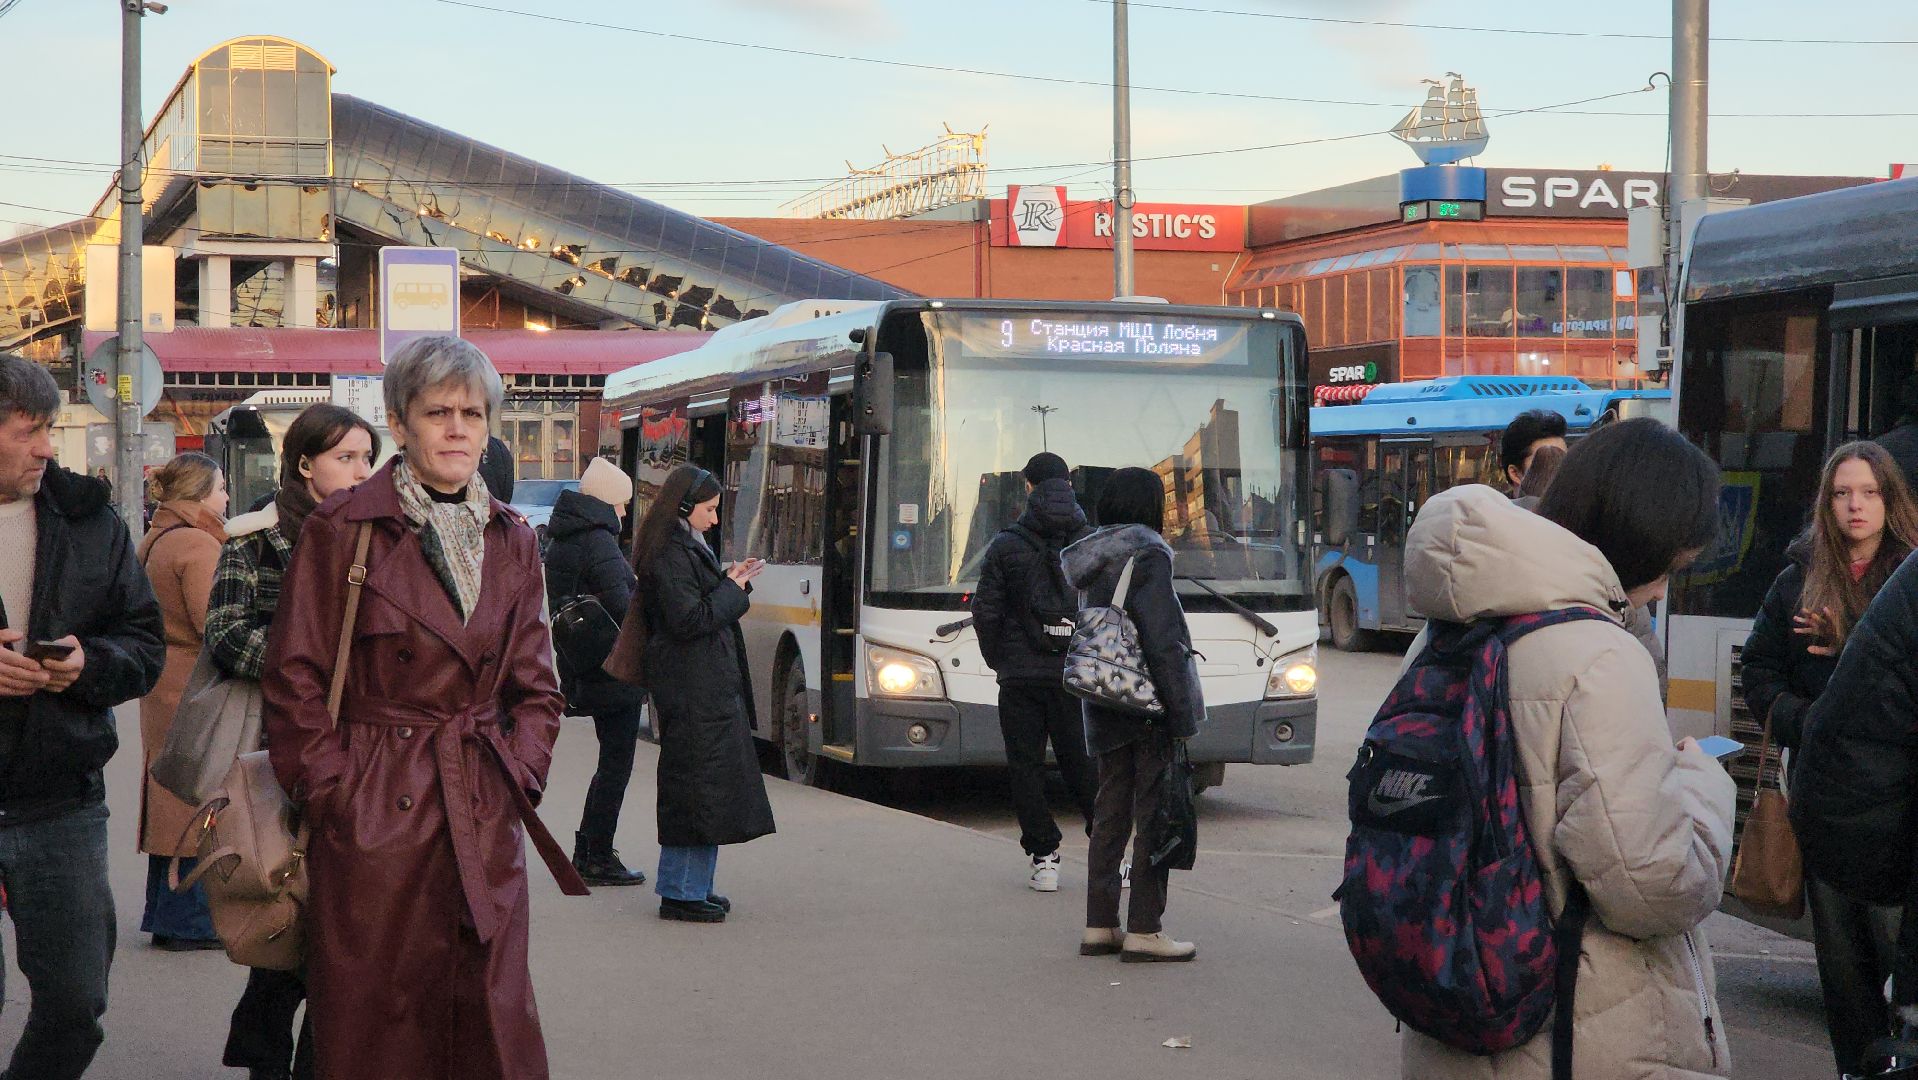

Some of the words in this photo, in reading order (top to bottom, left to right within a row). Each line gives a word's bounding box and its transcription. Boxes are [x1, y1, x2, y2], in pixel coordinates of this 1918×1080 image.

[1501, 176, 1659, 210] SPAR
[1001, 320, 1014, 348] 9
[1030, 319, 1110, 338] Станция
[1119, 321, 1154, 341] МЦД
[1163, 323, 1218, 341] Лобня
[1047, 336, 1126, 353] Красная
[1135, 338, 1202, 355] Поляна
[1329, 365, 1366, 383] SPAR
[1376, 769, 1434, 799] NIKE
